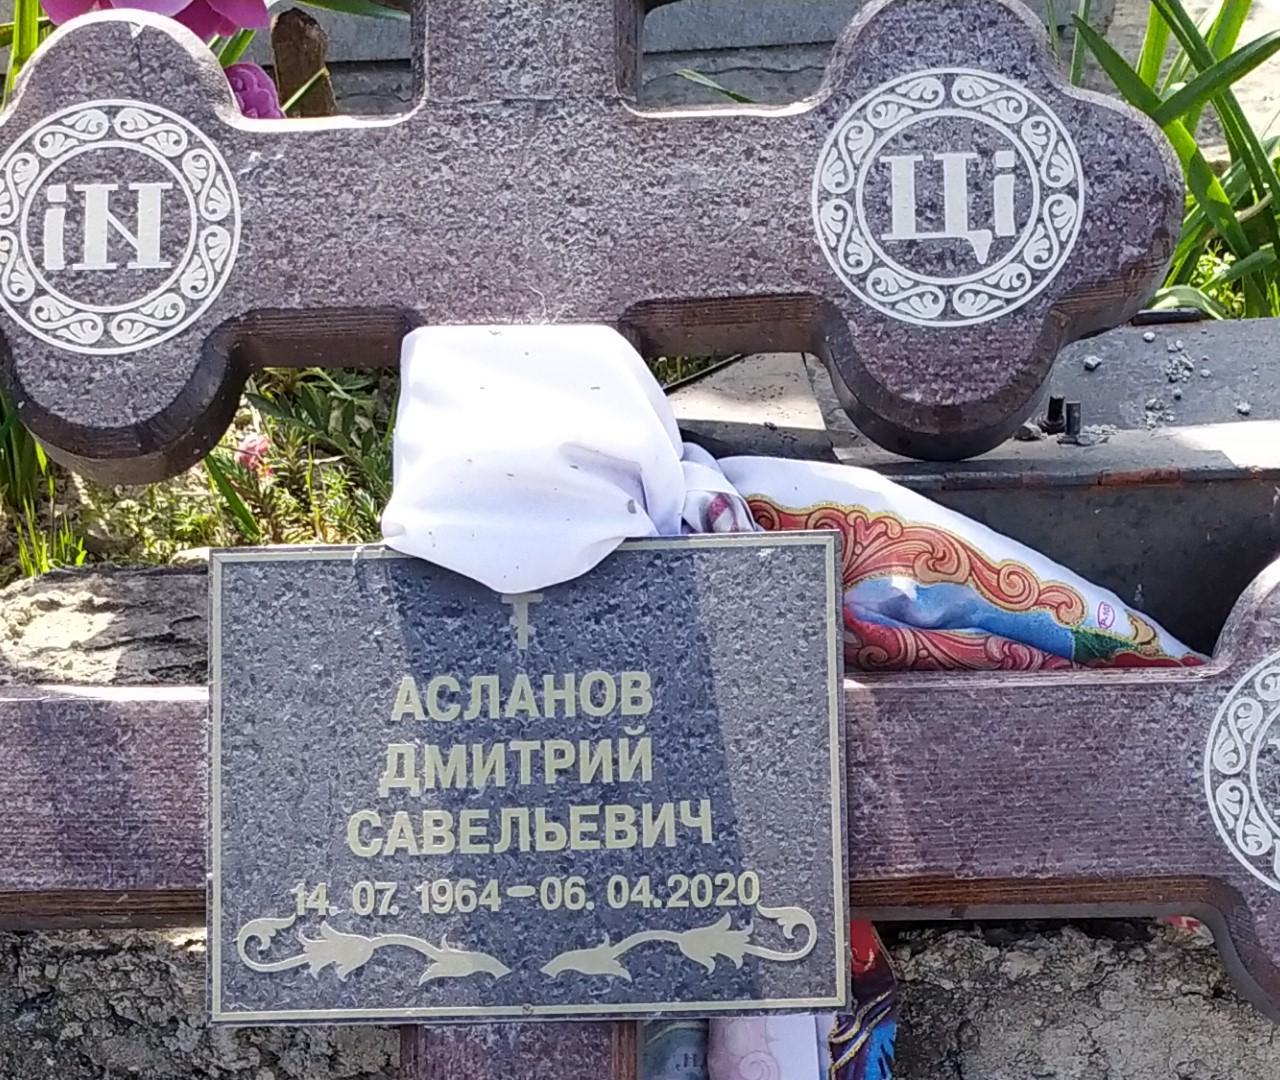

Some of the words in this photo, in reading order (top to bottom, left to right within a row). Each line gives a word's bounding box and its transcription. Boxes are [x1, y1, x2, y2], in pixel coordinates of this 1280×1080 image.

[390, 669, 654, 722] АСЛАНОВ
[377, 725, 654, 798] ДМИТРИЙ
[345, 798, 715, 858] САВЕЛЬЕВИЧ
